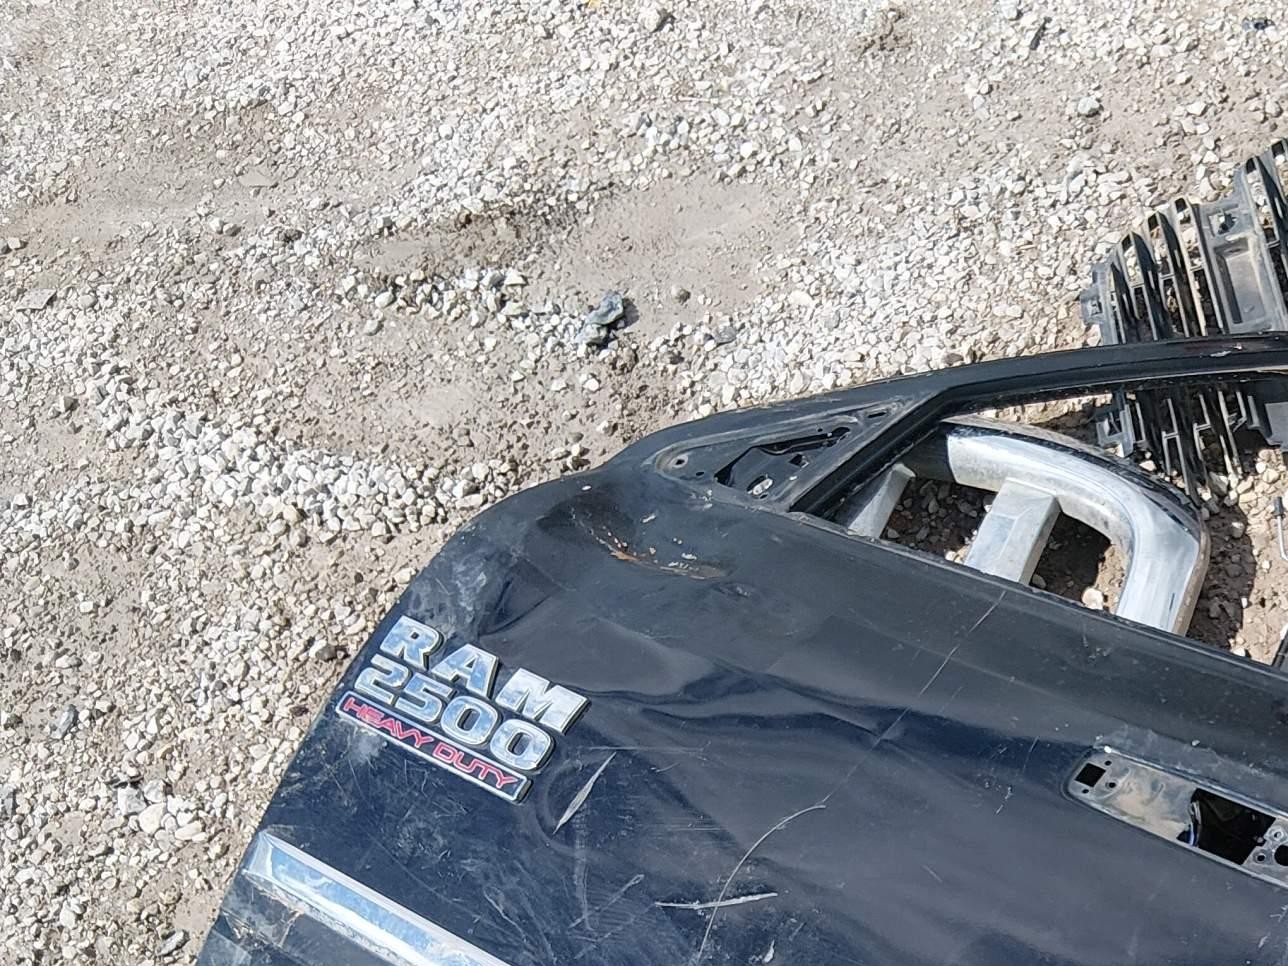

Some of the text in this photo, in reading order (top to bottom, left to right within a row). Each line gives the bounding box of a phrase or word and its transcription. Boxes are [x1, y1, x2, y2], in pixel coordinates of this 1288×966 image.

[354, 653, 555, 772] 2500
[380, 615, 591, 735] RAM
[343, 697, 518, 789] HEAVY DUTY
